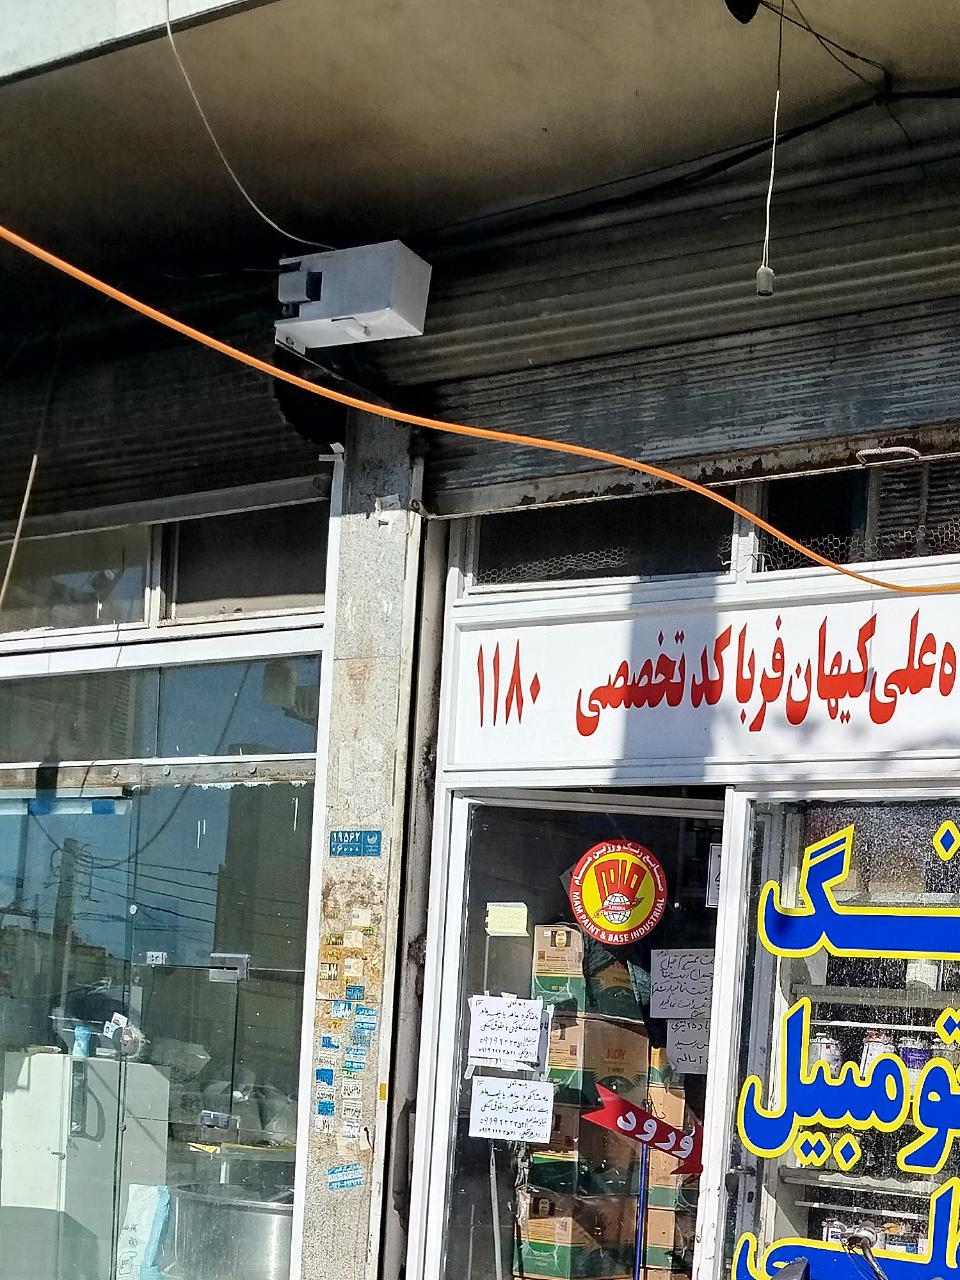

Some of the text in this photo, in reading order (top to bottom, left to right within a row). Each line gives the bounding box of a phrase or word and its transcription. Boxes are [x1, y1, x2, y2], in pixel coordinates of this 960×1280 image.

[477, 638, 541, 728] ۱۱۸۰
[575, 630, 686, 737] تخصصی
[689, 625, 733, 710] کد
[868, 606, 939, 725] علی
[572, 891, 665, 942] MAM PAINT & BASE INDUSTRIAL
[616, 1111, 696, 1159] ورود
